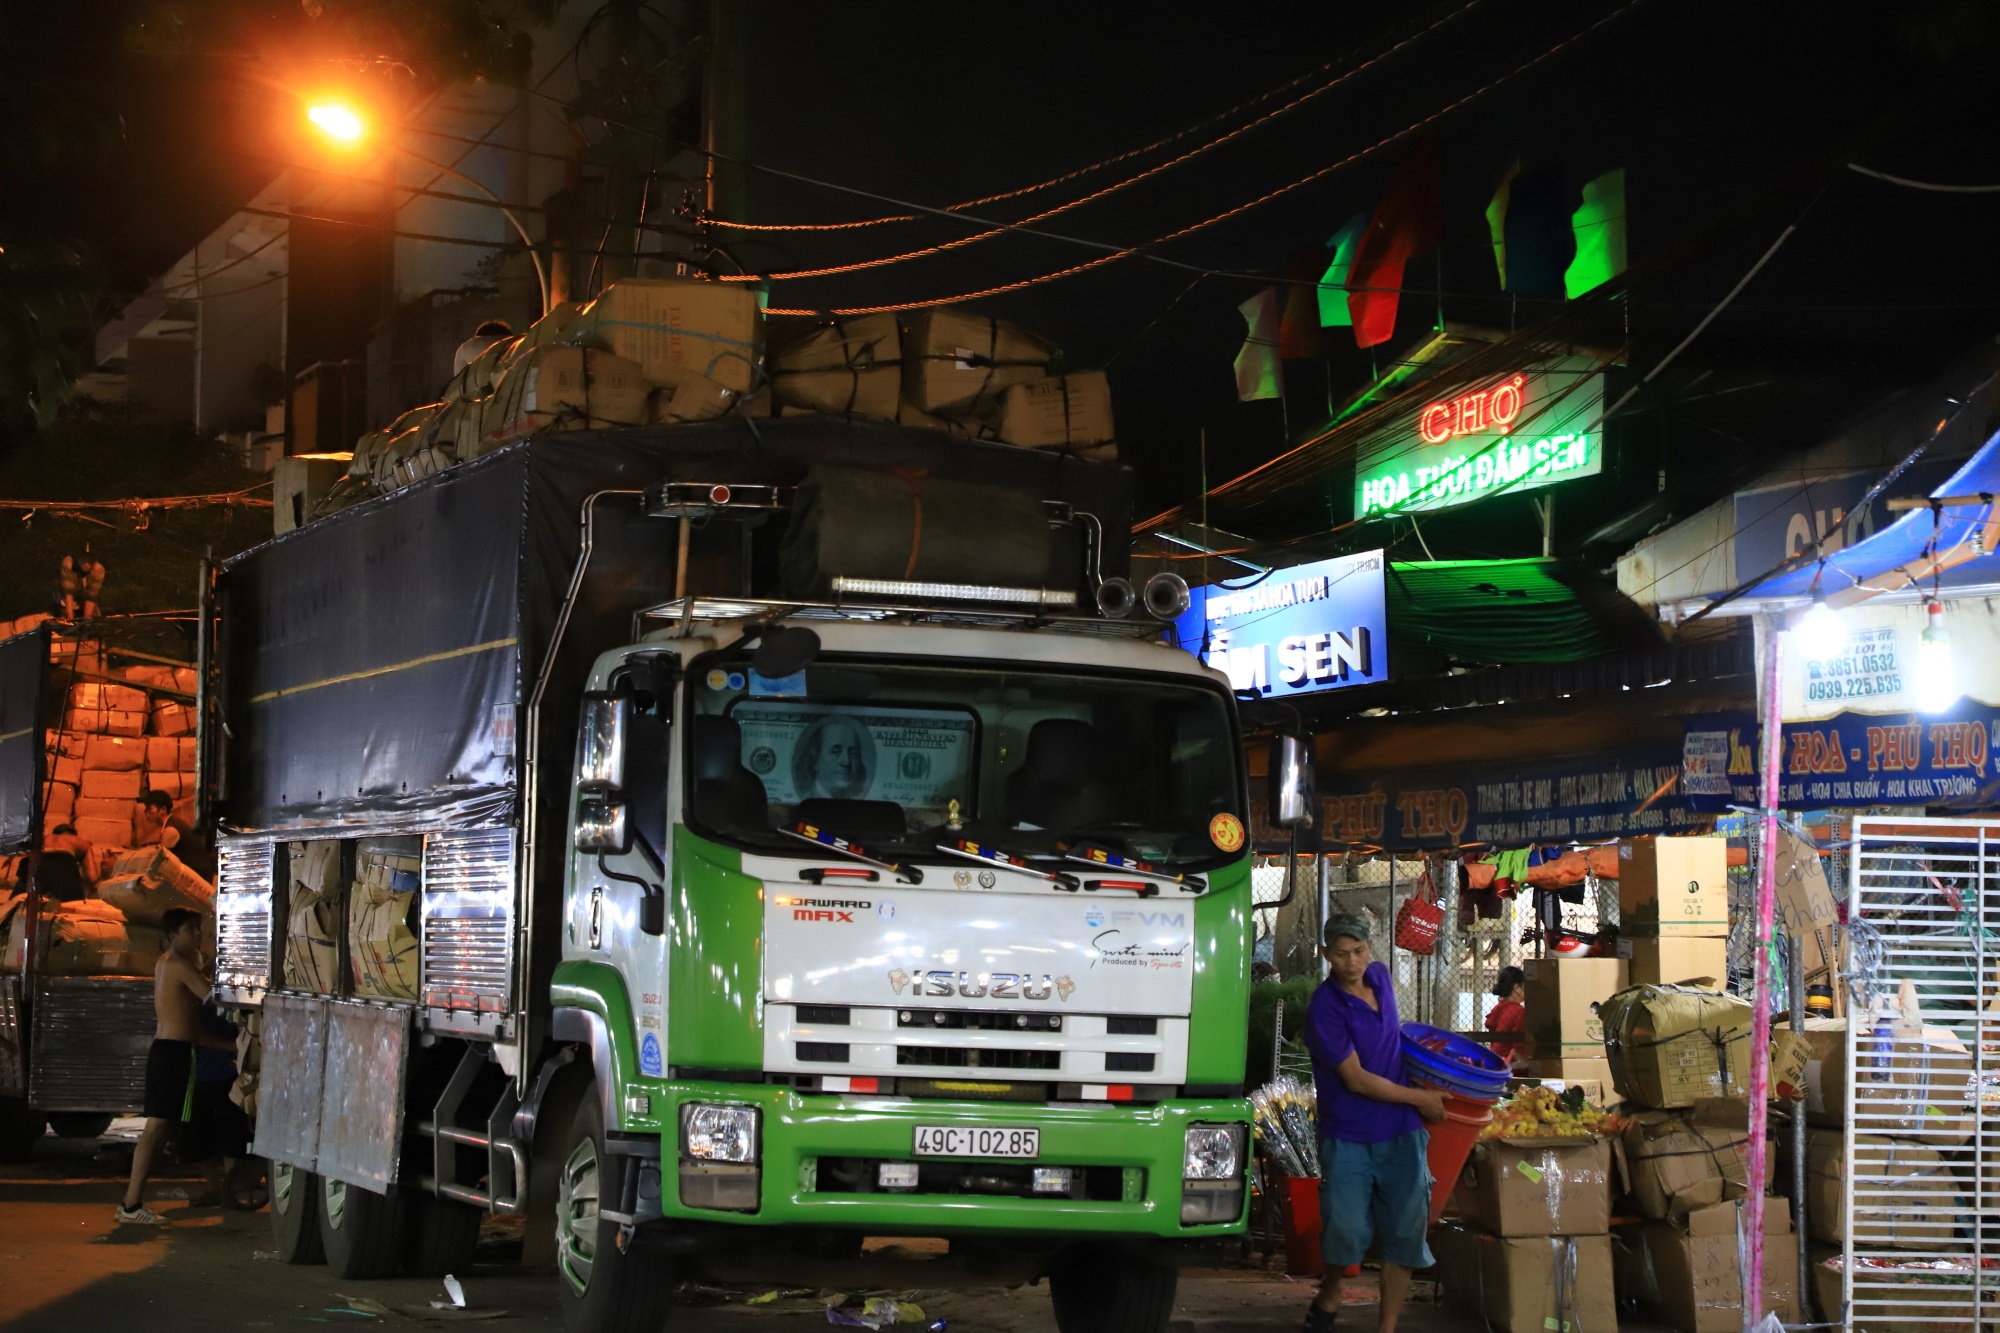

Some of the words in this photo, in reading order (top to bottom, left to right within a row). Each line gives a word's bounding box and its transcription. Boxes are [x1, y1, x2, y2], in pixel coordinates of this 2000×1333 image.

[1420, 376, 1525, 444] CHỢ
[1362, 472, 1411, 513] HOA
[1416, 455, 1472, 500] TƯƠI
[1535, 431, 1587, 477] SEN
[1278, 627, 1370, 688] SEN
[1809, 674, 1902, 700] 0939.225.635
[1790, 730, 1848, 775] HOA
[1867, 715, 1922, 774] PHÚ
[1928, 721, 1988, 779] THỌ
[1535, 778, 1552, 809] HOA
[1634, 768, 1655, 800] HOA
[1812, 782, 1831, 800] HOA
[1833, 782, 1854, 800] CHIA
[1887, 779, 1906, 798] HOA
[1908, 779, 1935, 798] KHAI
[1321, 781, 1387, 841] PHÚ
[1396, 787, 1468, 847] THỌ
[797, 822, 867, 855] ISUZU
[958, 839, 1025, 868] ISUZU
[1086, 847, 1153, 873] ISUZU
[775, 896, 872, 909] ORWARD
[794, 910, 854, 923] MAX
[1111, 911, 1186, 929] FVM
[1102, 957, 1138, 966] Produced
[1140, 957, 1149, 968] by
[1150, 959, 1184, 971] Sports
[912, 969, 1053, 1001] ISUZU
[918, 1129, 1037, 1155] 49C-102.85
